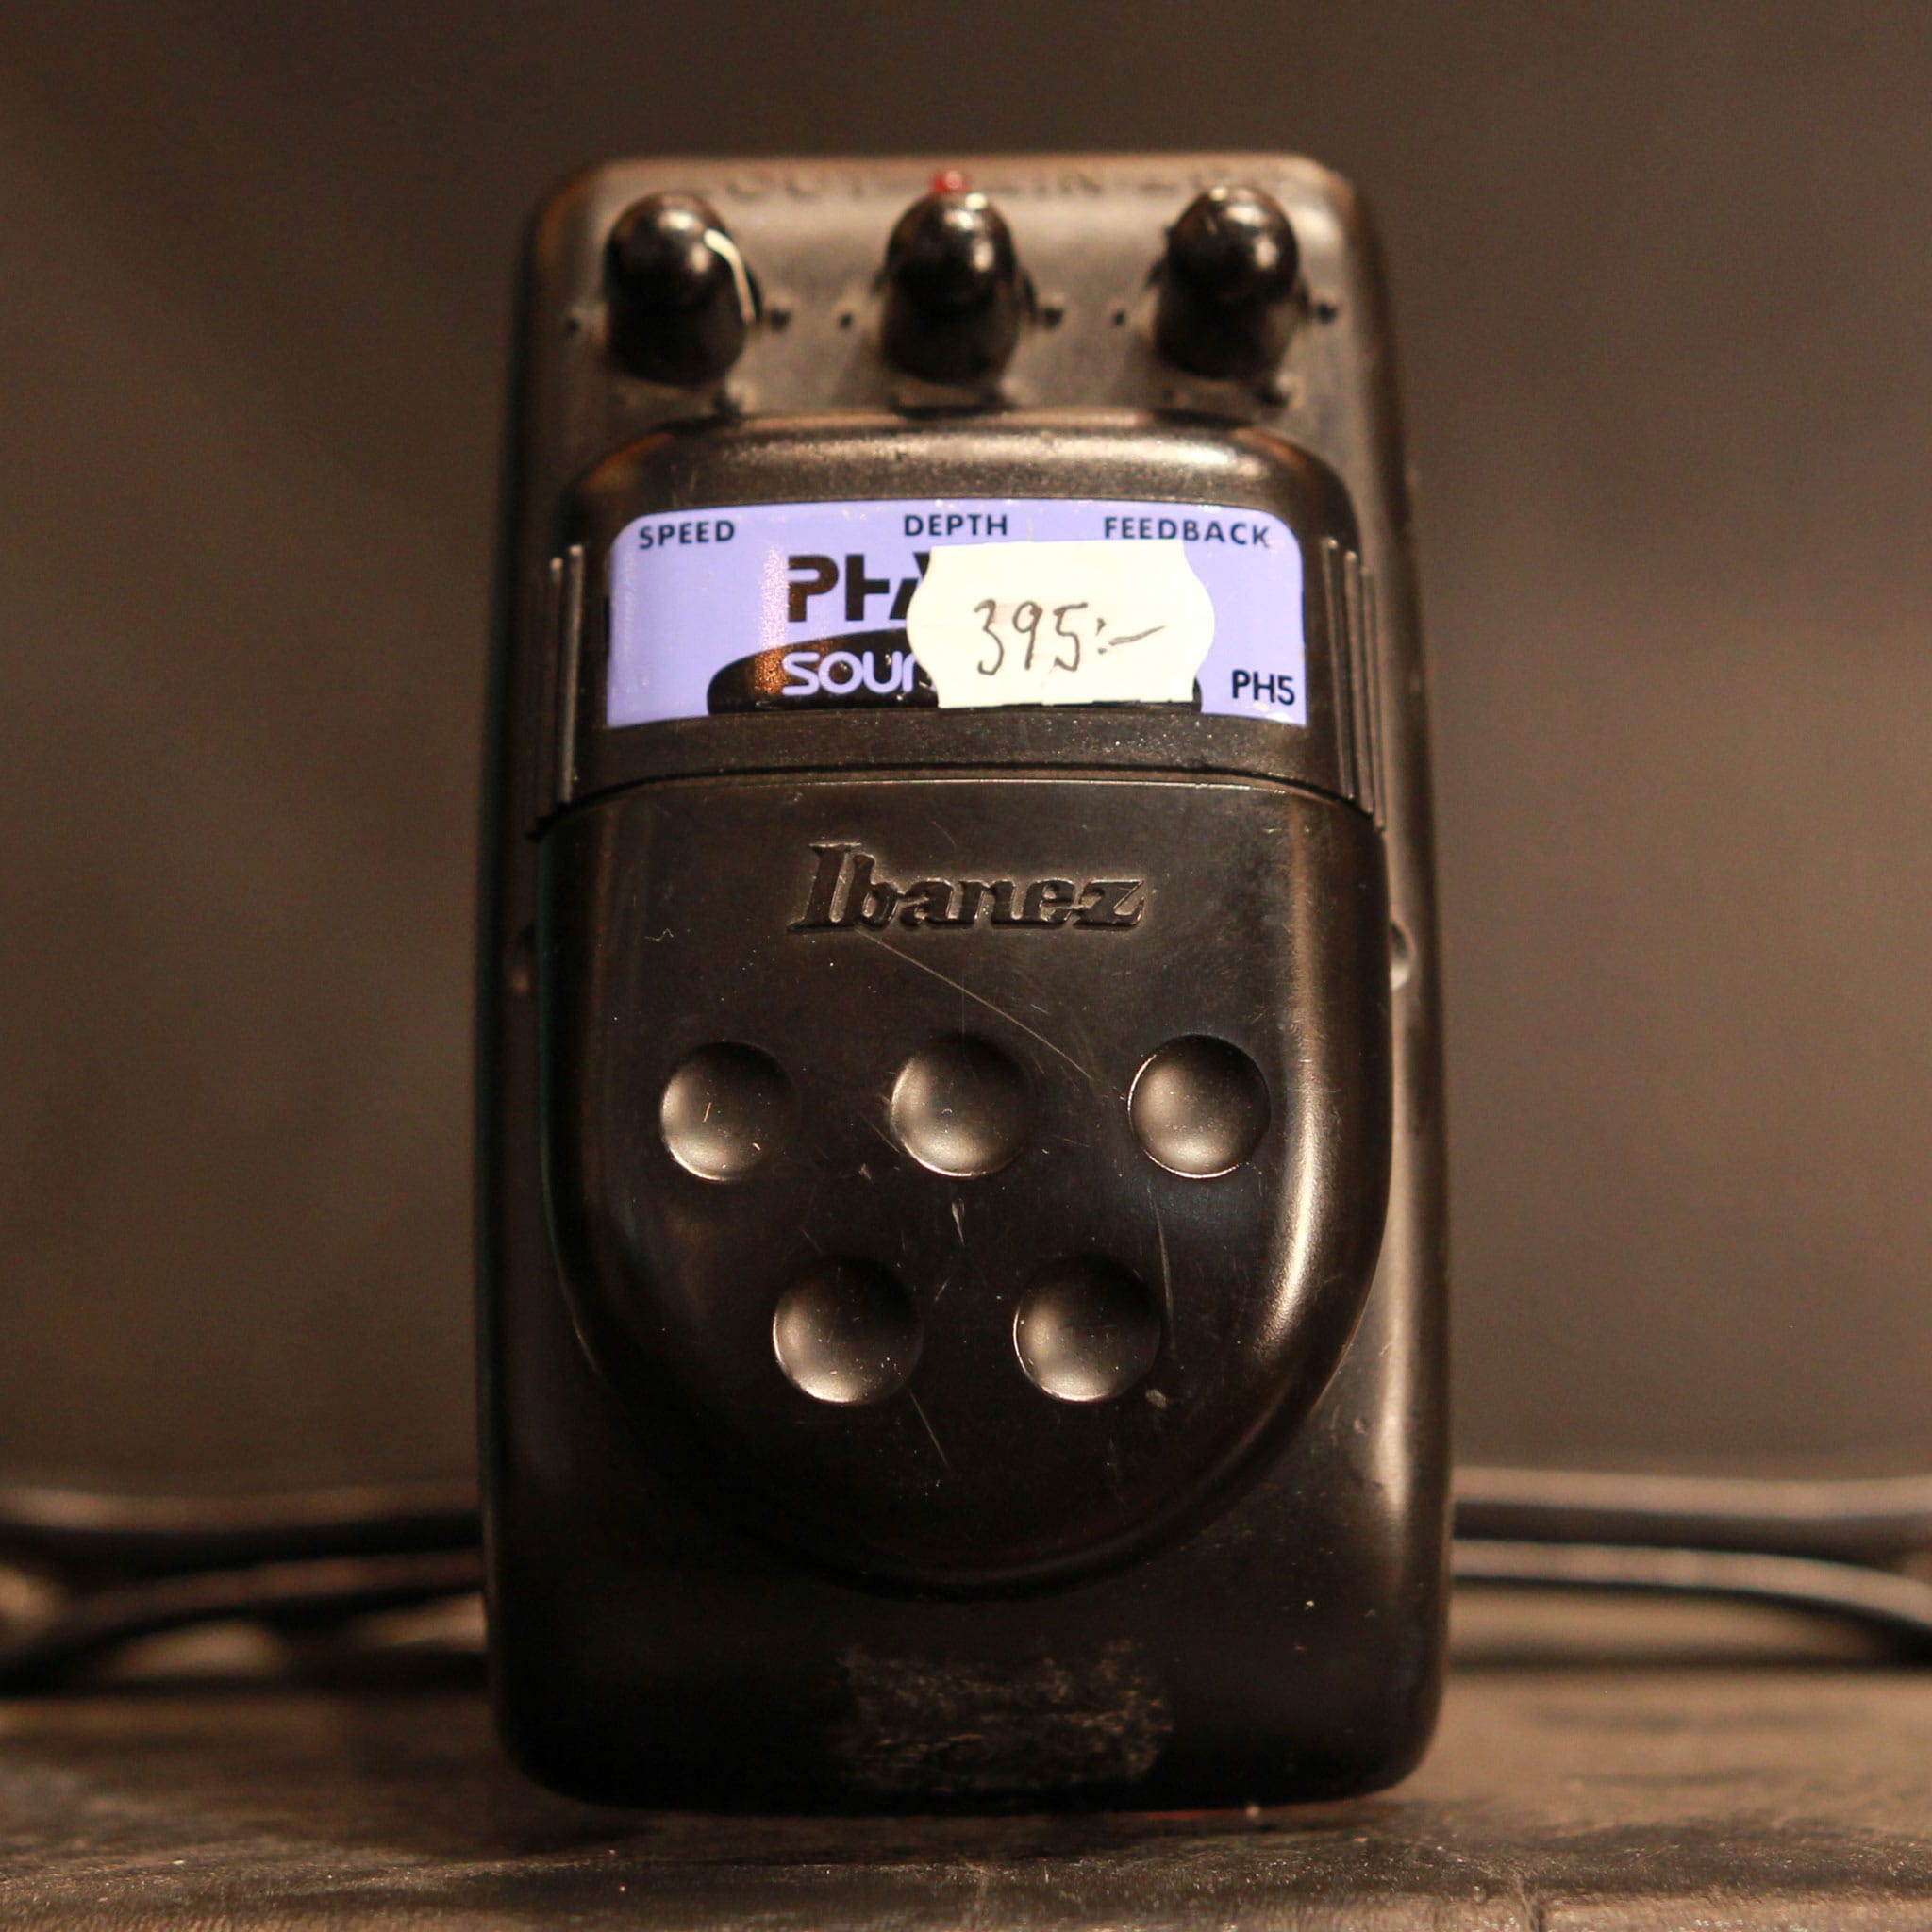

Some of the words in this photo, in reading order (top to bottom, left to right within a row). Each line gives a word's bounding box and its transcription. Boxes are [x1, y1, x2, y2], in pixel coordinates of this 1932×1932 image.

[638, 520, 735, 550] SPEED
[903, 513, 1008, 538] DEPTH
[1103, 516, 1271, 548] FEEDBACK
[787, 552, 932, 623] PHA
[1231, 669, 1296, 706] PH5
[786, 841, 1147, 932] Ibanez
